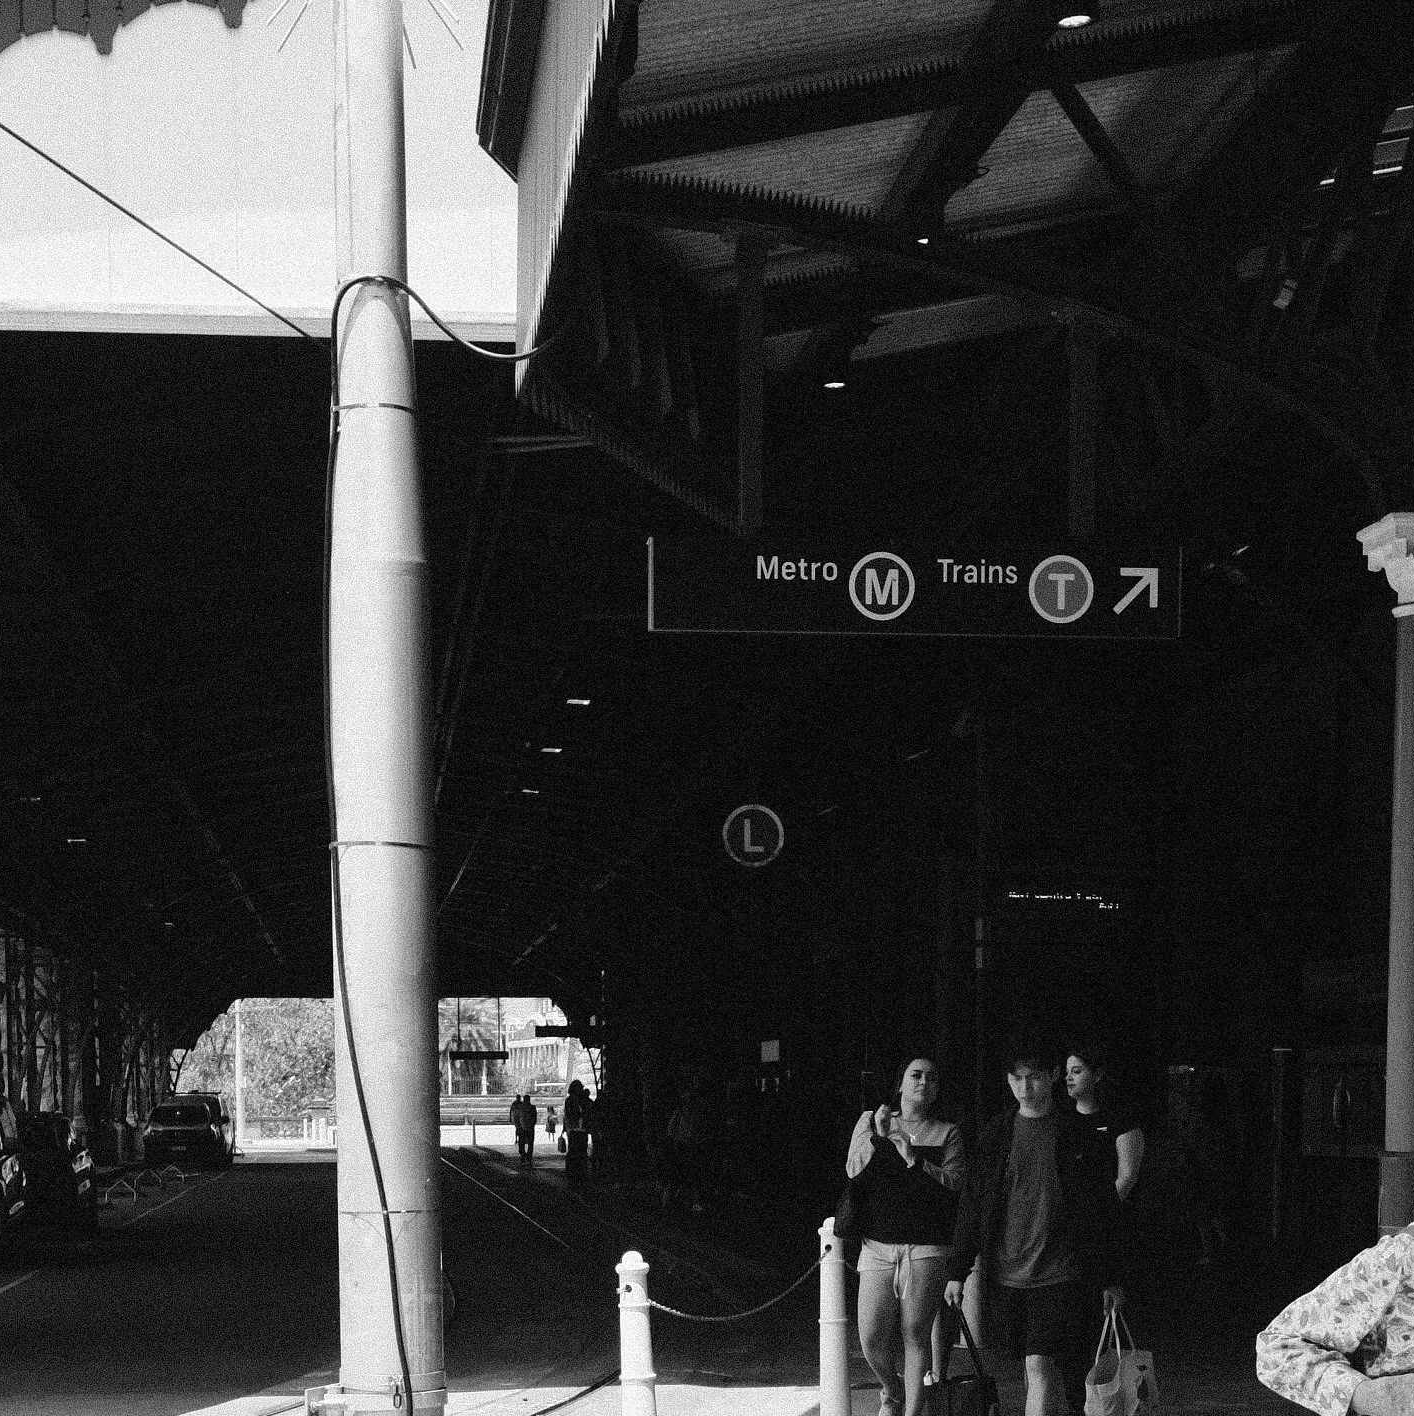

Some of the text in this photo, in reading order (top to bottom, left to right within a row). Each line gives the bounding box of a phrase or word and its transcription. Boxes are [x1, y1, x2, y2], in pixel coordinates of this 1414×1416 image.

[756, 555, 1076, 610] Metro M Trains T
[743, 818, 765, 852] L
